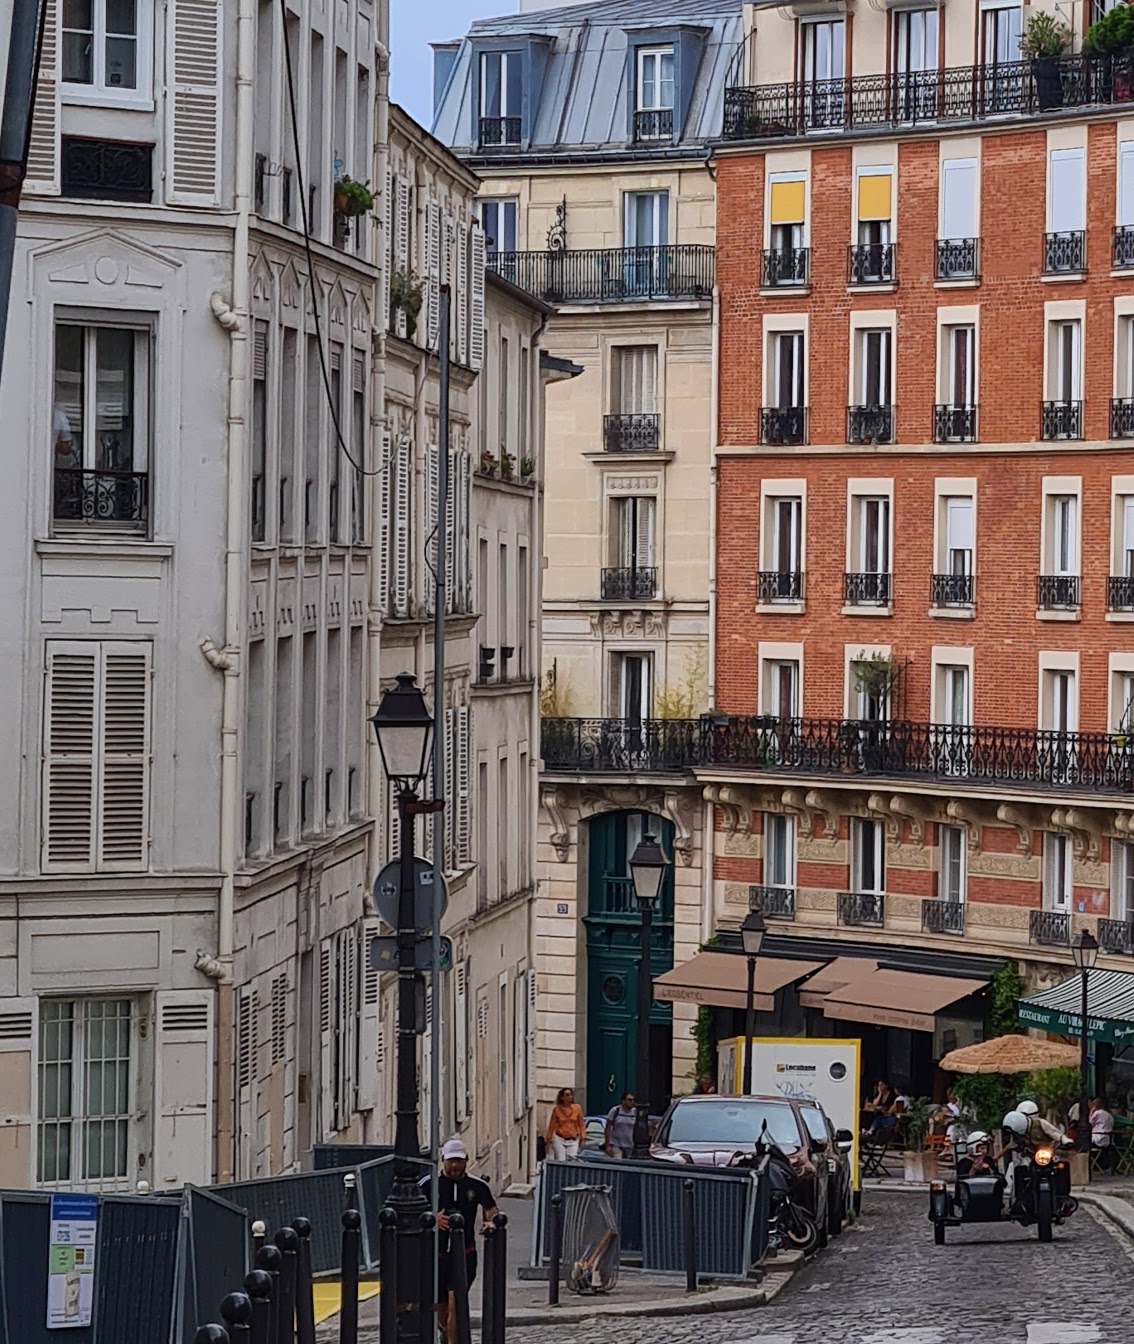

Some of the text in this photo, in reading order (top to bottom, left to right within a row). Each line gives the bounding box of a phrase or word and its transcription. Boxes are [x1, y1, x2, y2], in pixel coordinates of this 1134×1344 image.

[1018, 1009, 1051, 1024] RESTAURANT
[1058, 1014, 1068, 1024] AU
[1089, 1019, 1107, 1031] LEPIC
